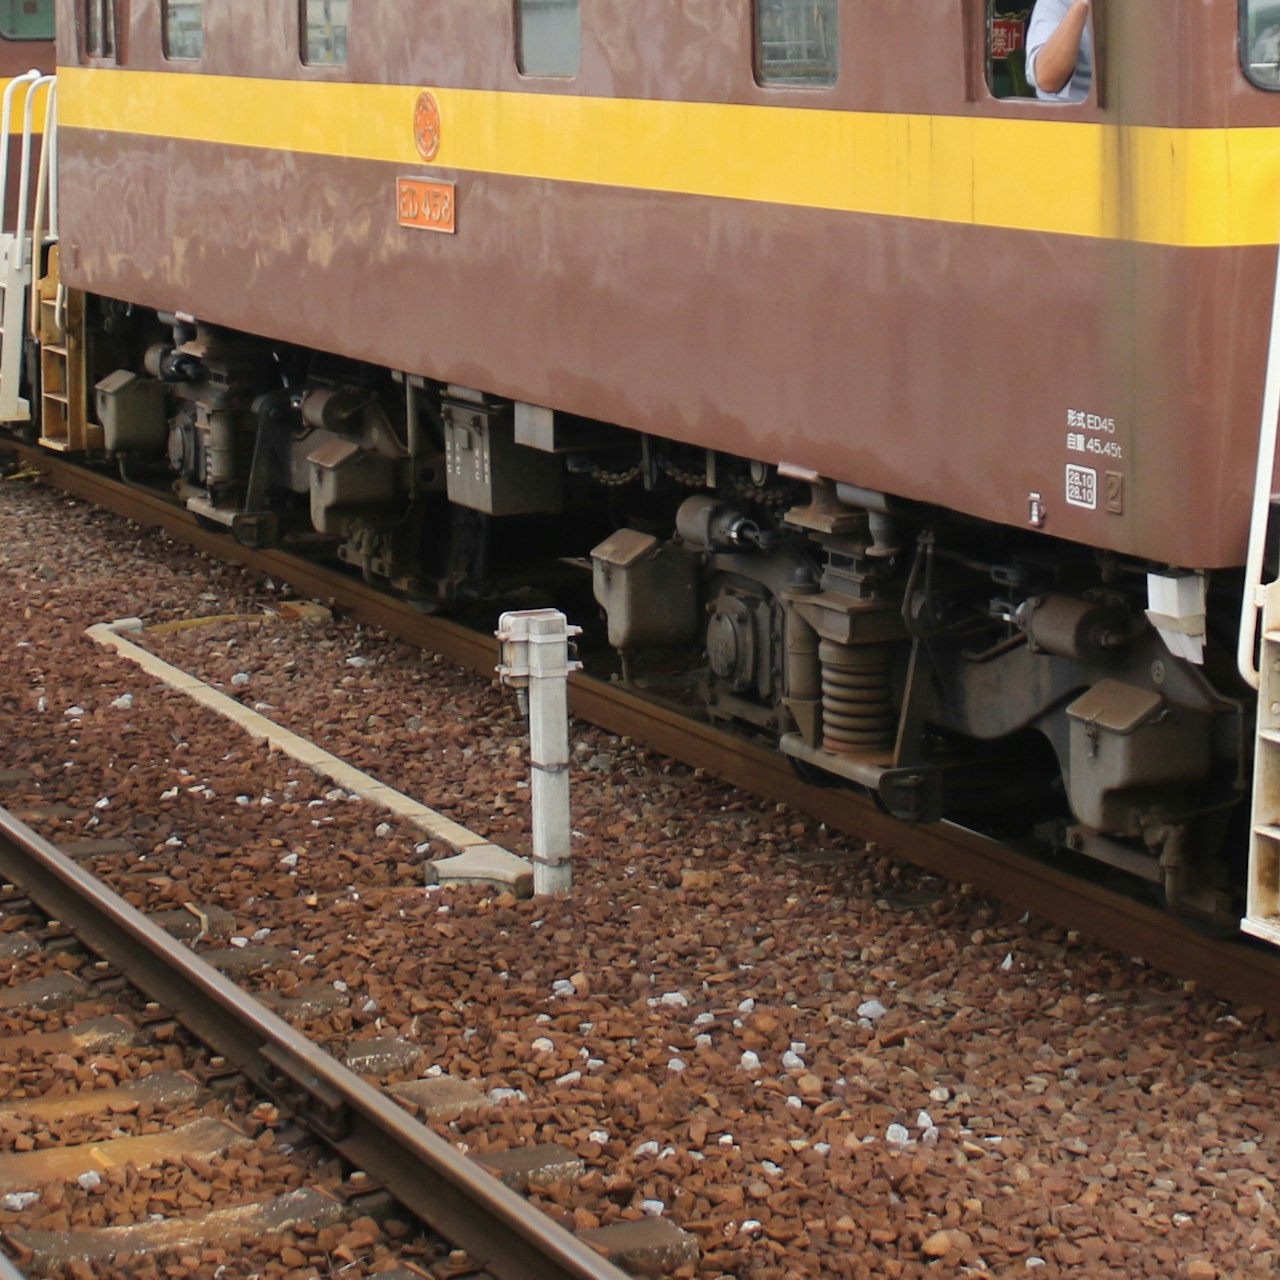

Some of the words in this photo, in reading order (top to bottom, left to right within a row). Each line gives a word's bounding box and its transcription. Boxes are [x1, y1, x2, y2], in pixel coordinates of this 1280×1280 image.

[400, 184, 419, 219] ED
[421, 189, 451, 223] 458
[1066, 408, 1086, 429] 形式
[1086, 414, 1116, 434] ED45
[1066, 432, 1086, 452] 自重
[1086, 438, 1122, 459] 45.45t
